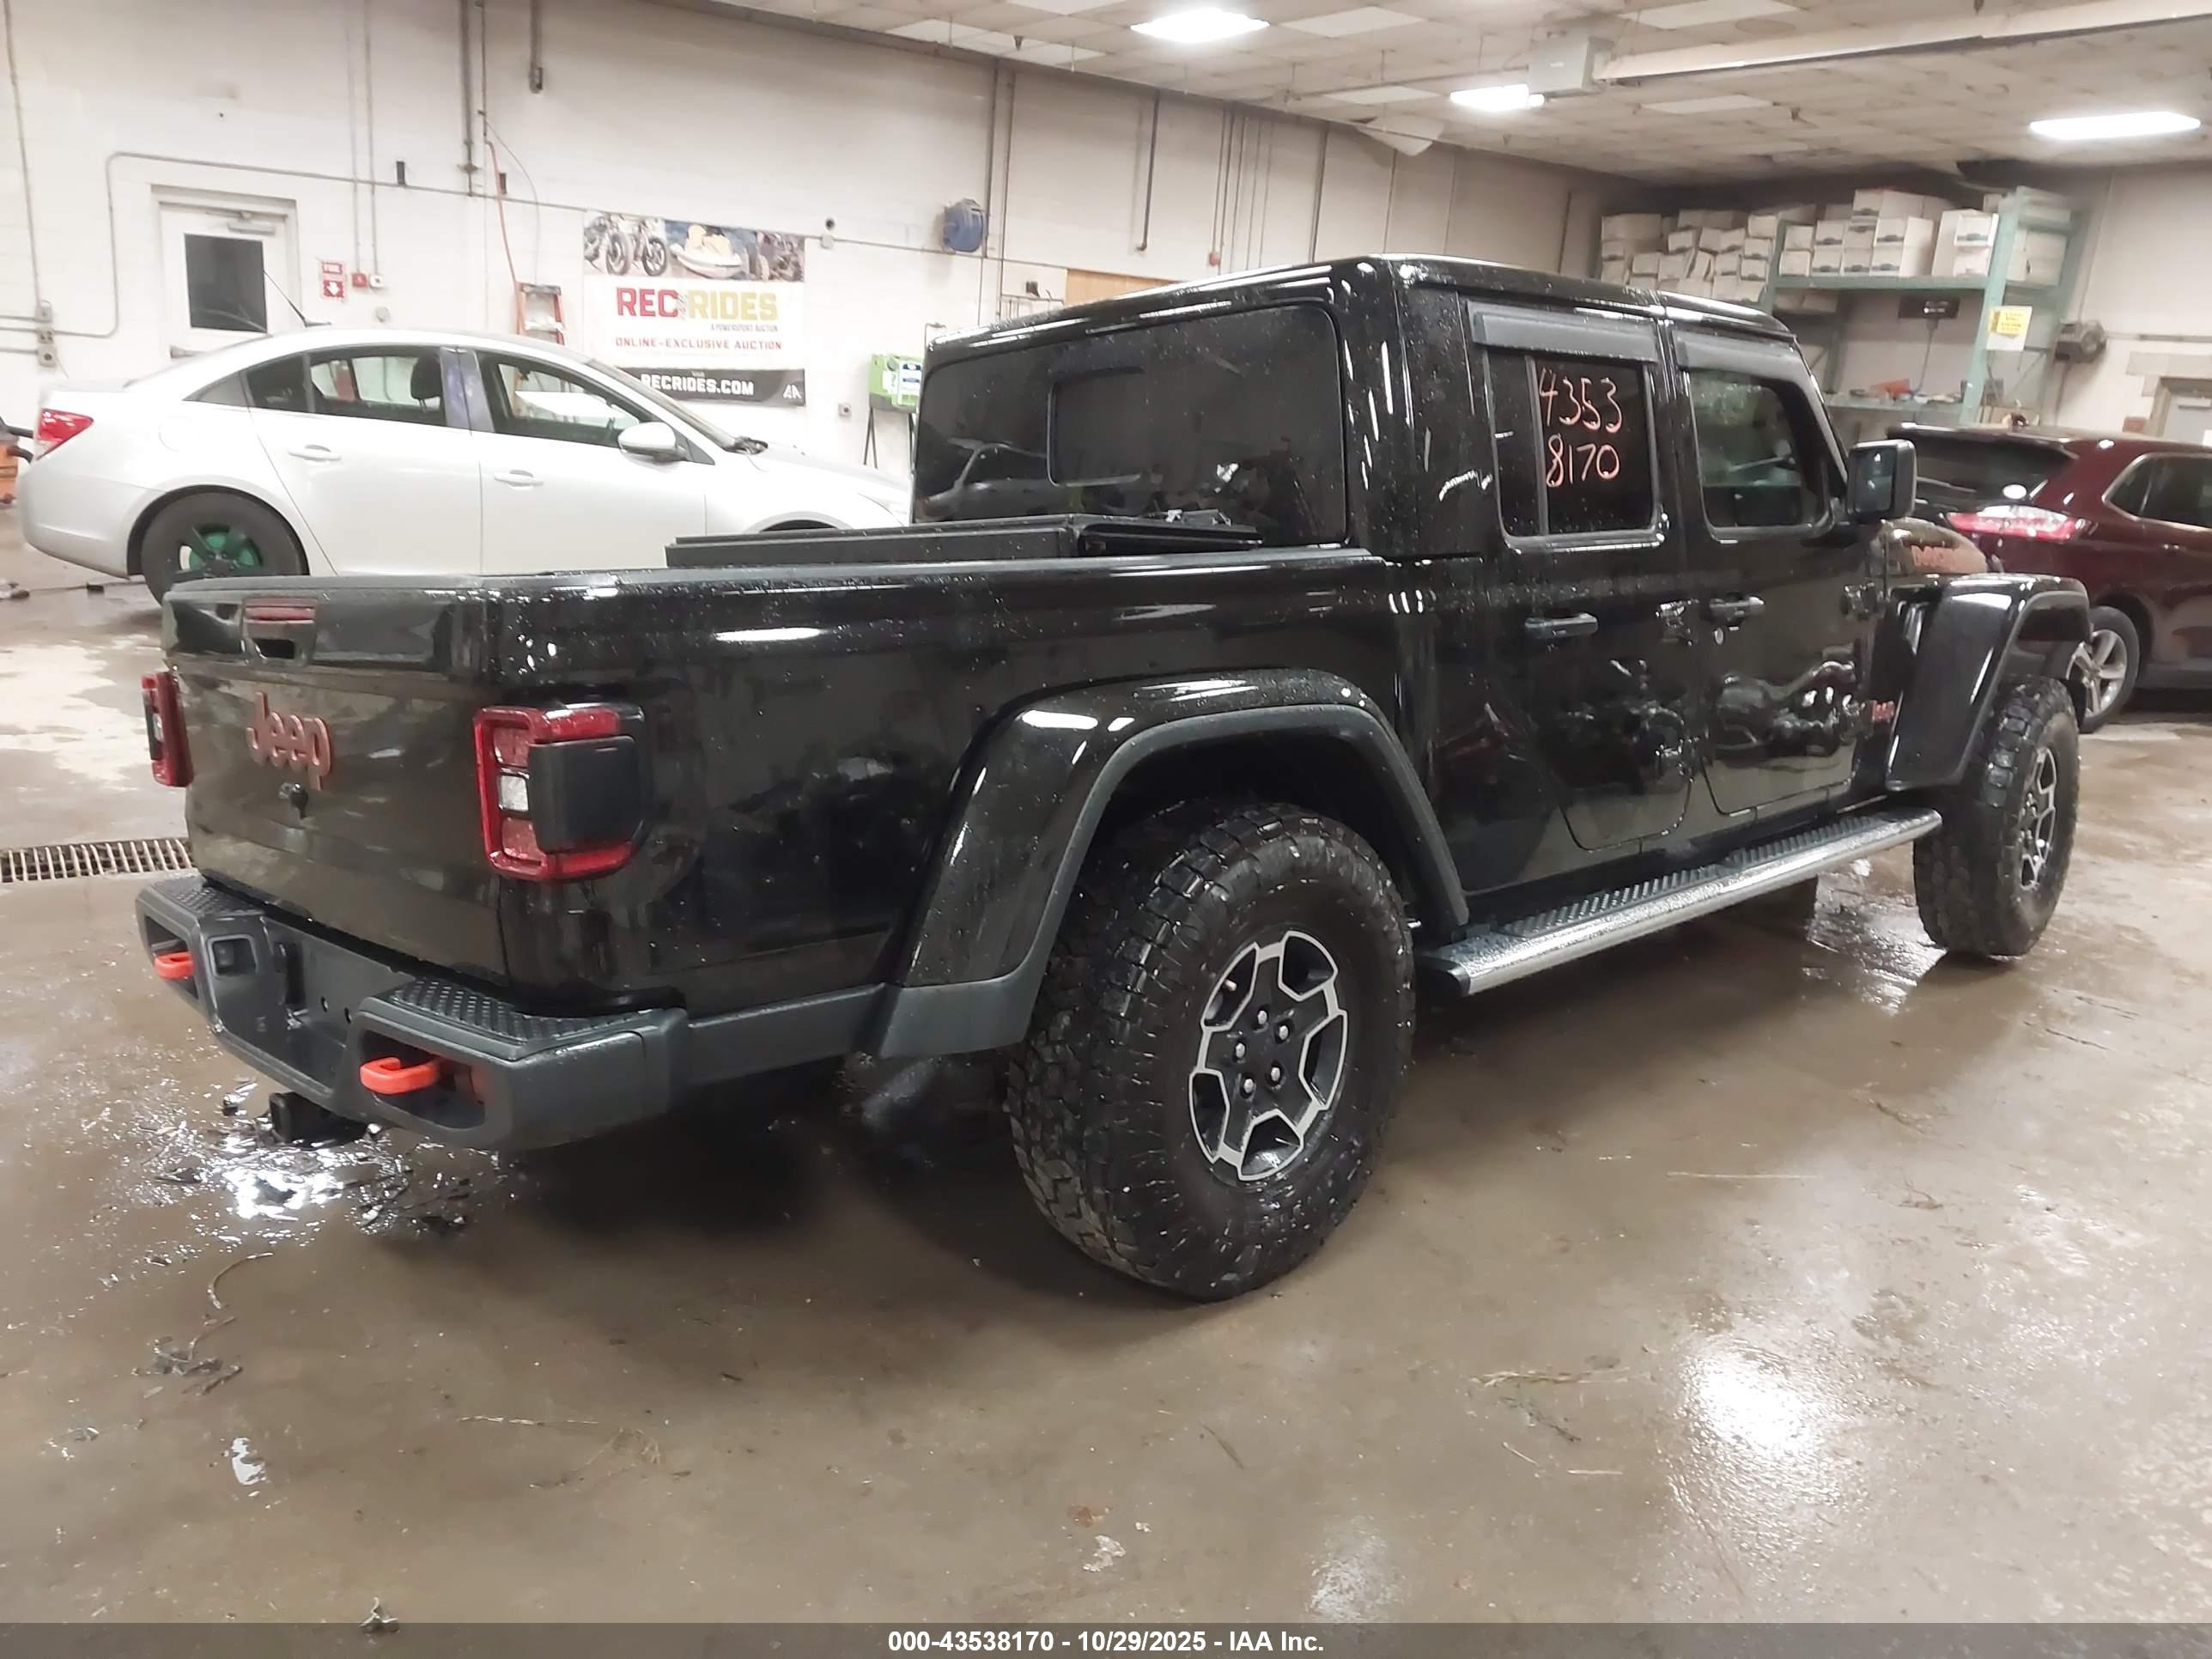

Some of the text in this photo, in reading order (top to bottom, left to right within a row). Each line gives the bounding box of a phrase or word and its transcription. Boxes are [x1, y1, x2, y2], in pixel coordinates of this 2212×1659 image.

[616, 288, 778, 321] REC RIDES
[615, 337, 781, 350] ONLINE-EXCLUSIVE AUCTION
[641, 374, 754, 396] RECRIDES.COM
[1539, 367, 1623, 434] 4353
[1546, 432, 1620, 487] 8170
[246, 691, 332, 791] Jeep
